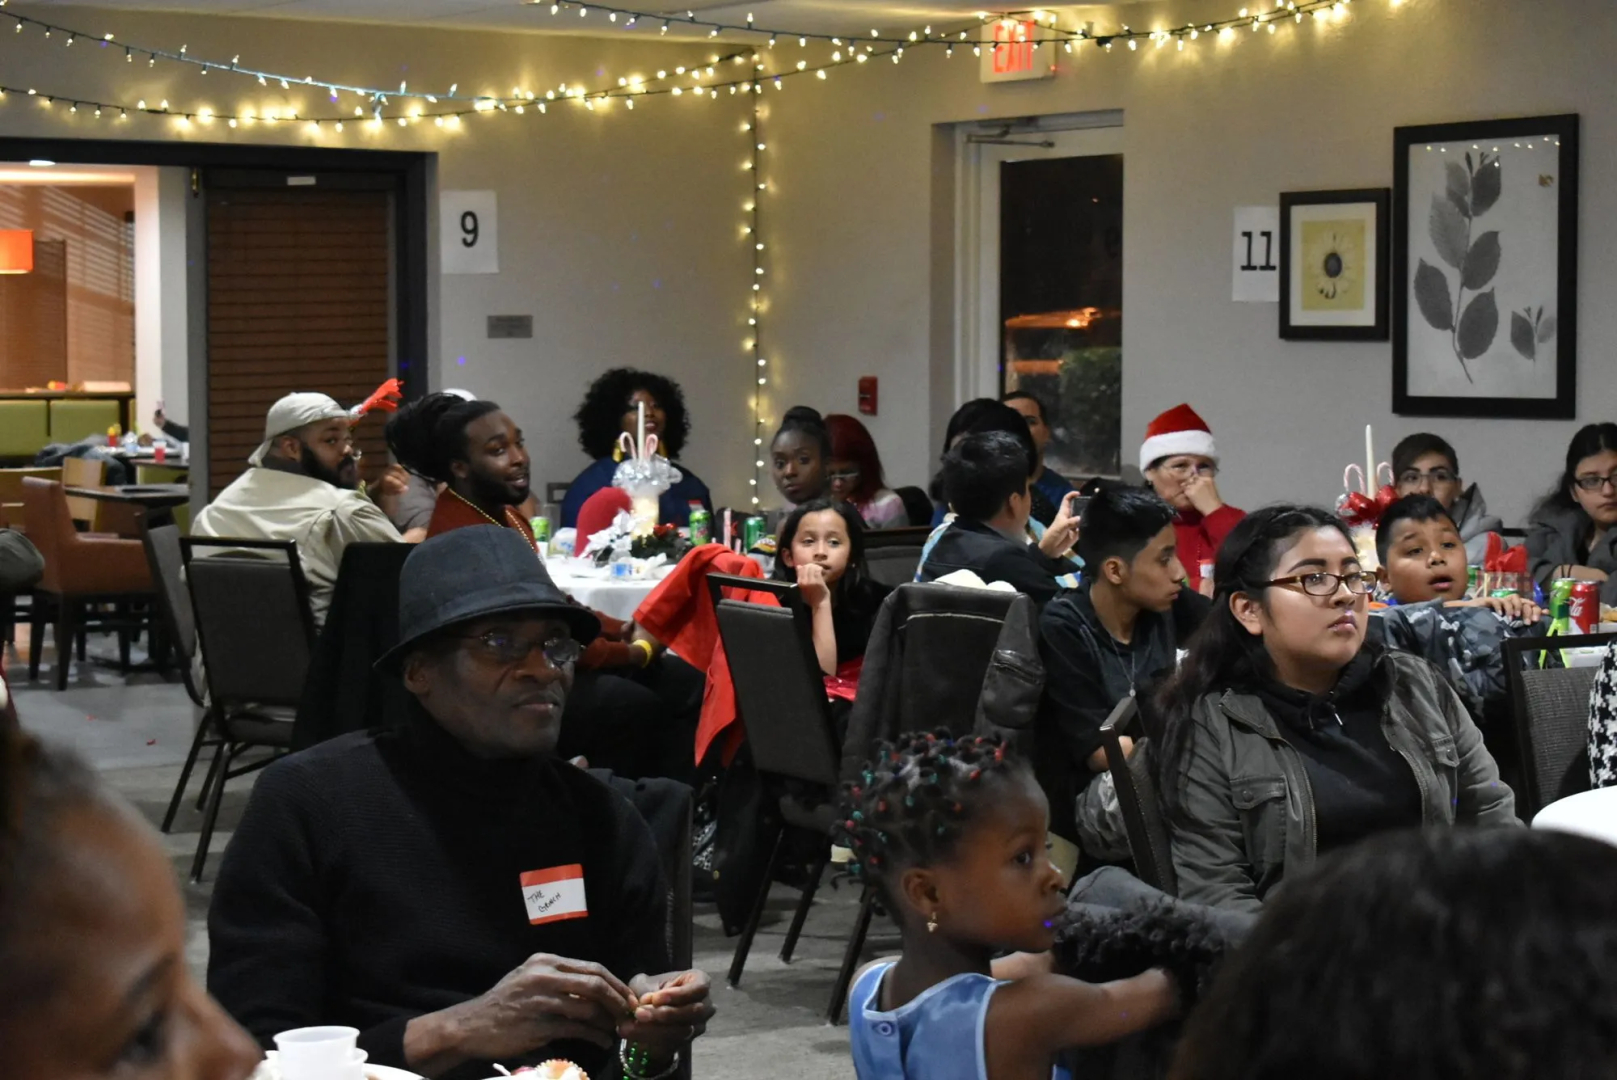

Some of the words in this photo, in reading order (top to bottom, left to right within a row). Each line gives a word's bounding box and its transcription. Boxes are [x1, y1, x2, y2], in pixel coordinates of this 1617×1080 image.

[993, 20, 1036, 73] EXIT
[461, 210, 479, 248] 9
[1240, 231, 1277, 271] 11
[527, 890, 545, 903] THE
